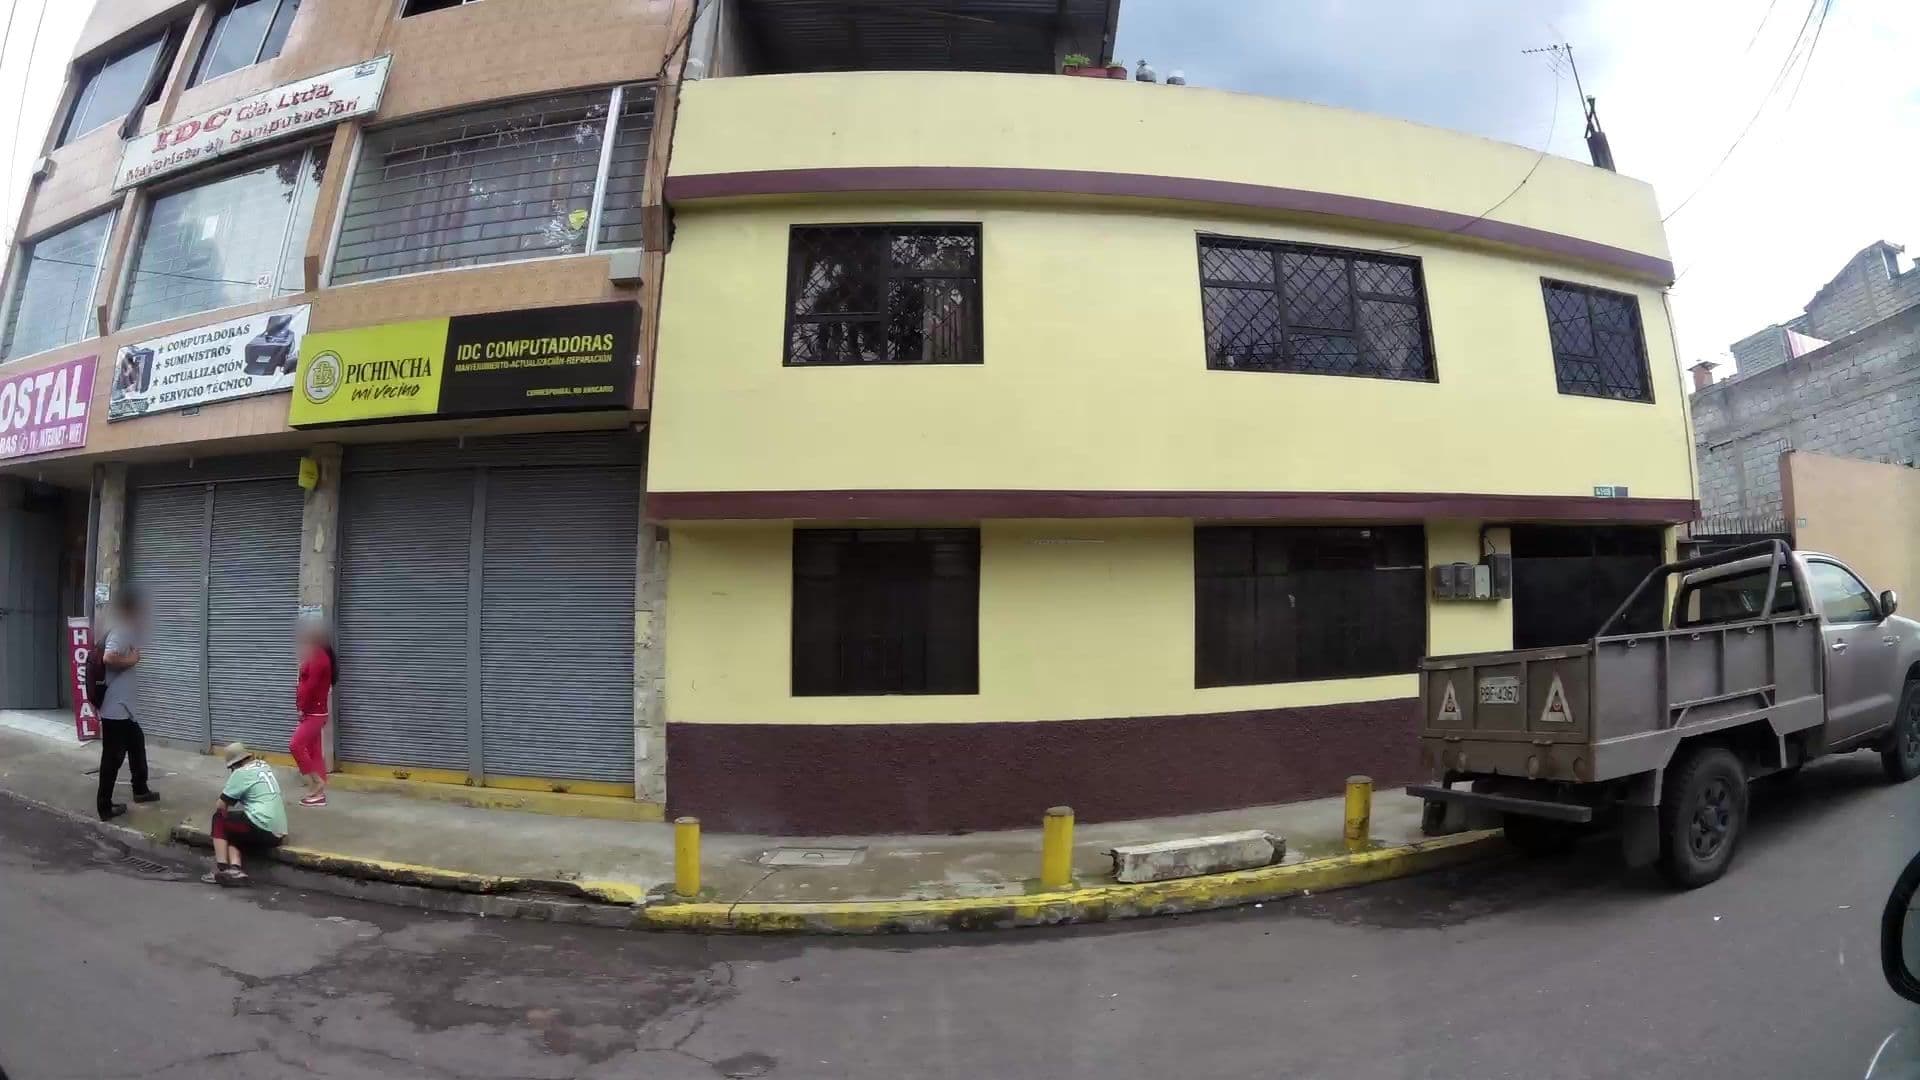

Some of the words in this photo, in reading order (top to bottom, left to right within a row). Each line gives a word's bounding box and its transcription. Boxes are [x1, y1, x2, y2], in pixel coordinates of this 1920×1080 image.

[151, 107, 233, 154] IDC
[166, 323, 251, 352] COMPUTADORAS
[457, 343, 482, 361] IDC
[485, 333, 614, 359] COMPUTADORAS
[163, 344, 232, 368] SUMINISTROS
[161, 359, 244, 386] ACTUALIZACIÓN
[344, 356, 433, 385] PICHINCHA
[158, 386, 204, 404] SERVICIO
[73, 629, 97, 736] HOSTAL
